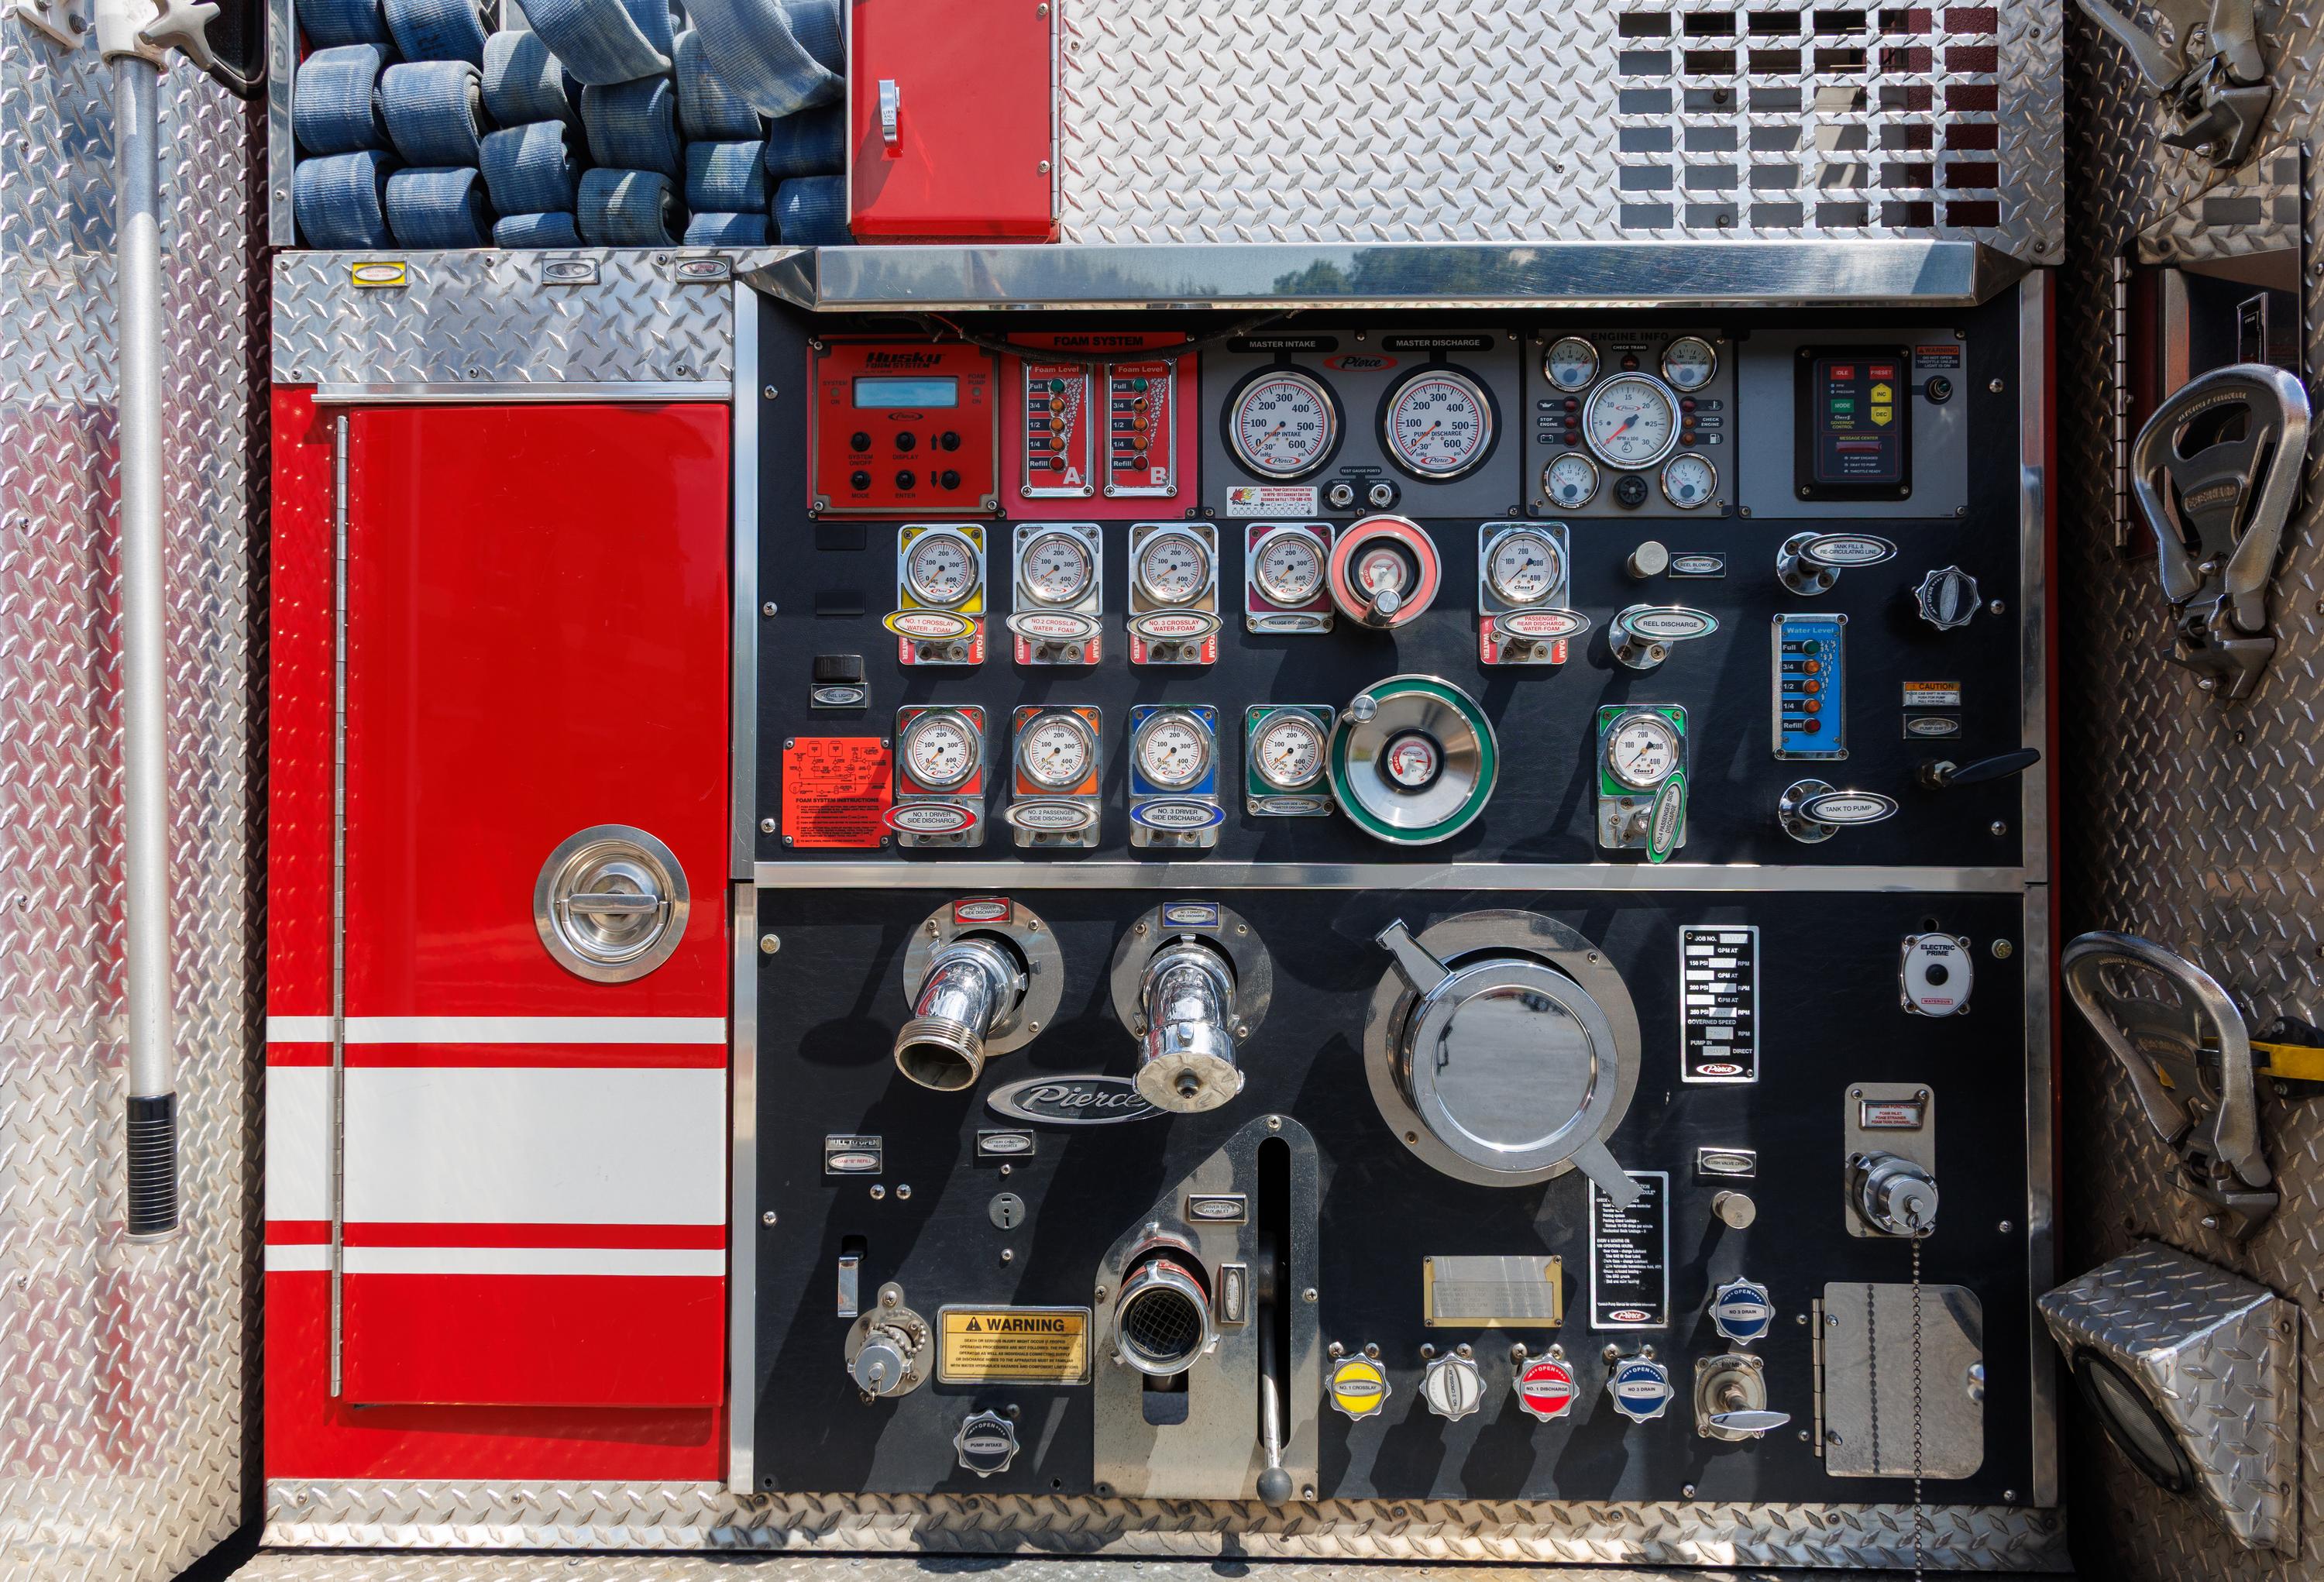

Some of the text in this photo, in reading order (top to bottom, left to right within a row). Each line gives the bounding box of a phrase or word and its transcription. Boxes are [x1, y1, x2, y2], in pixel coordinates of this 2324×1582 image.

[1591, 332, 1669, 341] ENGINE INFO
[1054, 337, 1143, 346] FOAM SYSTEM
[867, 353, 943, 365] Husky
[1341, 357, 1381, 370] Pierce
[1276, 394, 1292, 402] 300
[1292, 404, 1309, 413] 400
[1251, 419, 1267, 428] 100
[1297, 422, 1315, 431] 500
[1452, 421, 1469, 430] 500
[1288, 440, 1305, 449] 600
[1063, 467, 1081, 483] A
[1150, 467, 1168, 483] B
[1659, 803, 1671, 832] PASSENGER
[1666, 805, 1677, 834] DISCHARGE
[1707, 1065, 1733, 1074] Pierce
[1021, 1085, 1147, 1110] Pierce
[1618, 1312, 1641, 1320] Pierce
[987, 1319, 1064, 1331] WARNING
